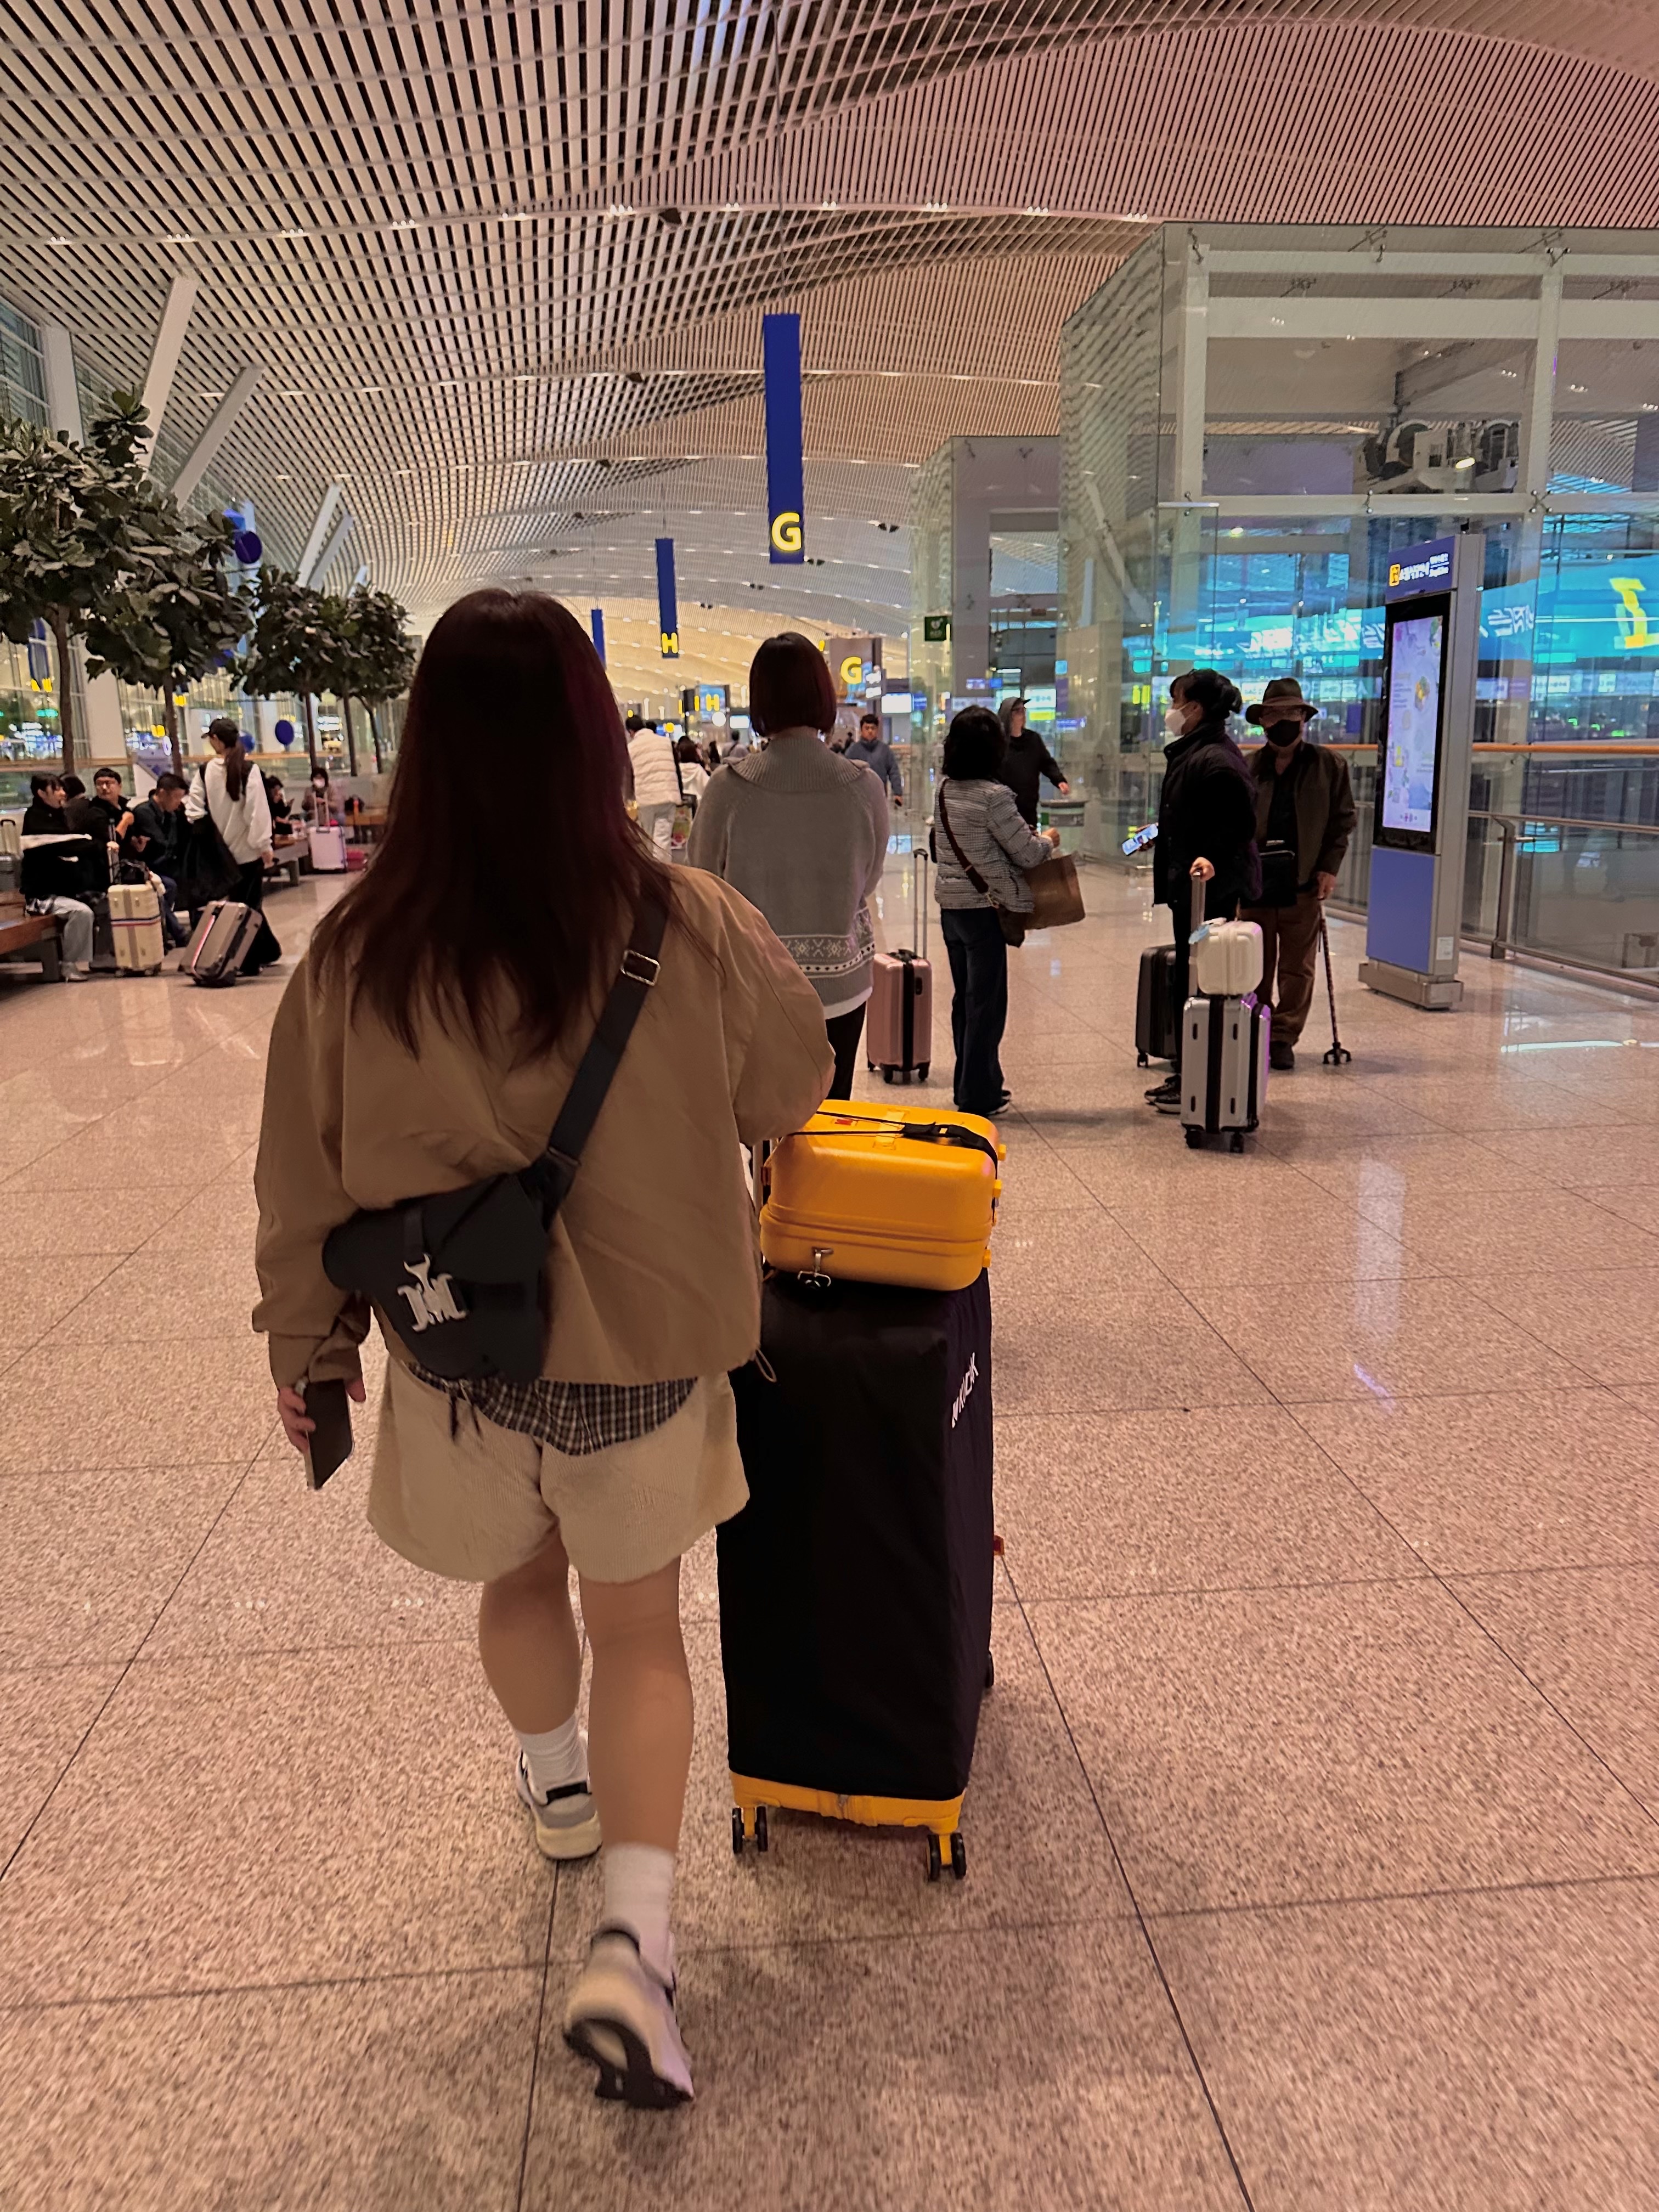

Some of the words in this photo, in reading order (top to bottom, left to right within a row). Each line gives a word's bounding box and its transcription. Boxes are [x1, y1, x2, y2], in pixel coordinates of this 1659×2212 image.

[771, 511, 802, 551] G
[662, 632, 678, 654] H
[840, 657, 862, 684] G
[706, 694, 720, 712] H
